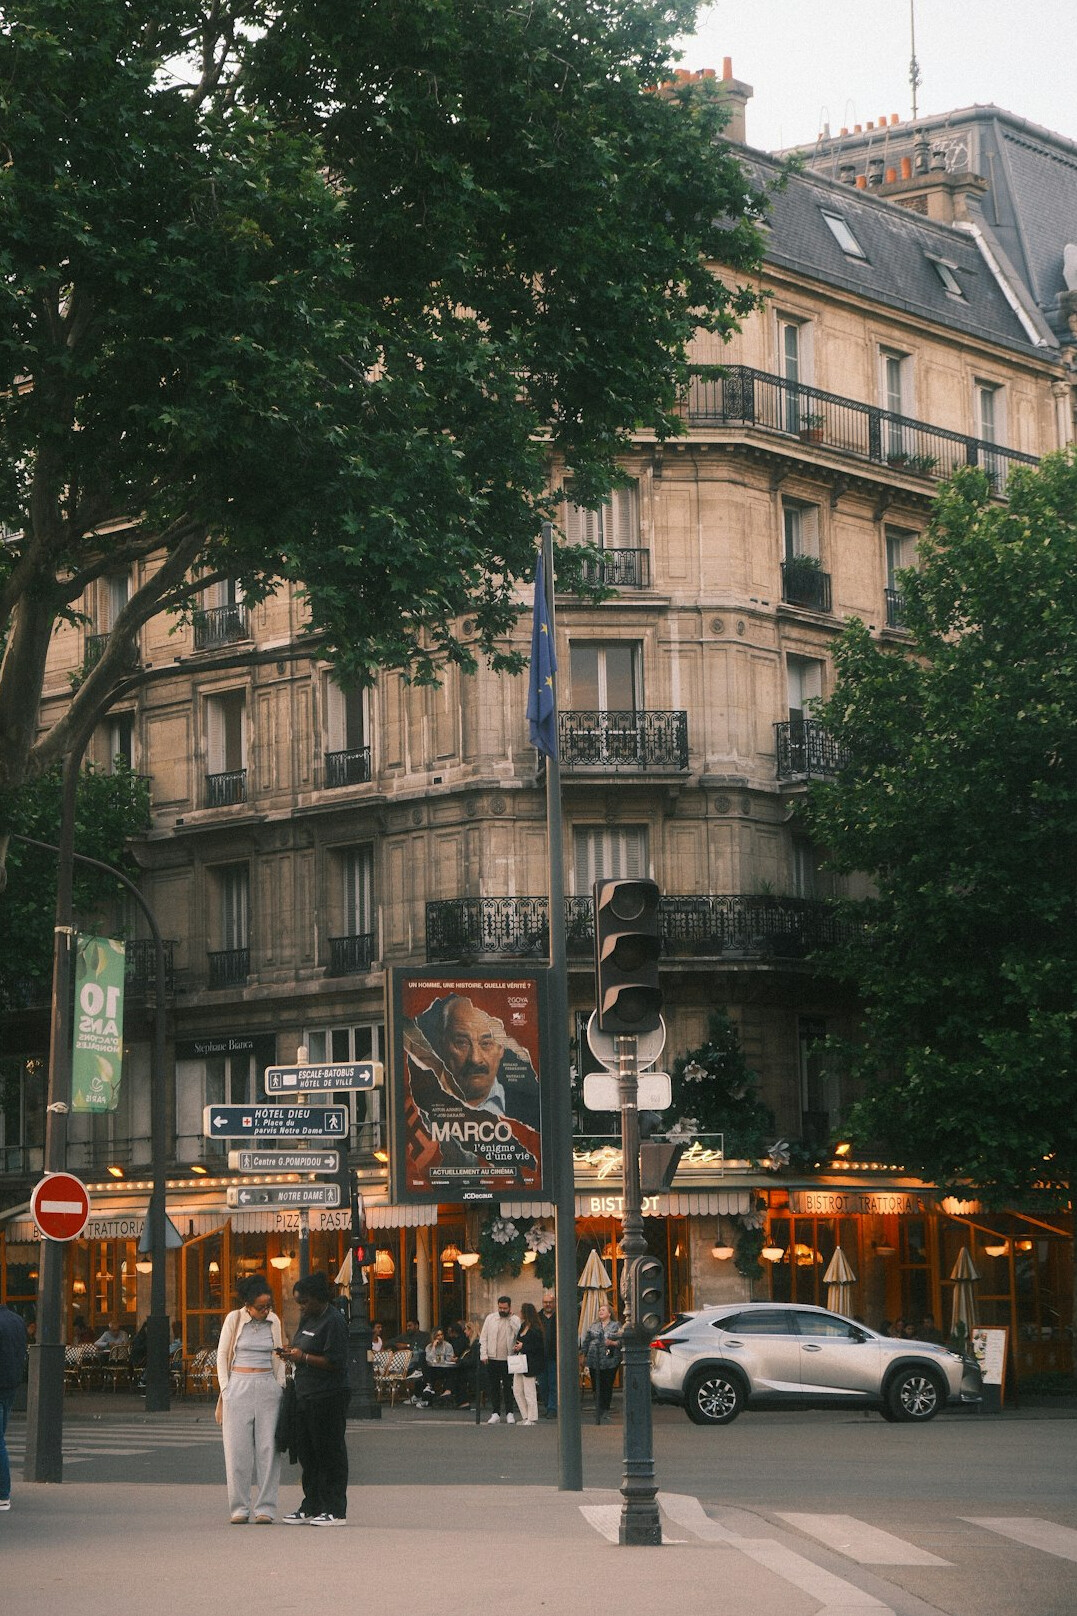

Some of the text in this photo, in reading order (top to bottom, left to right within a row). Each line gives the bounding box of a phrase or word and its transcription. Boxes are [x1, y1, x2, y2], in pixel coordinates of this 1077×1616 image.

[507, 981, 527, 989] VÉRITÉ
[298, 1067, 355, 1079] ESCALE-BATOBUS
[300, 1078, 353, 1088] HÔTEL DE VILLE
[254, 1108, 310, 1119] HÔTEL DIEU
[254, 1127, 277, 1135] parvis
[431, 1121, 512, 1142] MARCO
[474, 1144, 516, 1154] l'énigme
[253, 1157, 322, 1166] Centre G.POMPIDOU
[485, 1152, 530, 1161] d'une vie
[490, 1167, 514, 1175] CINÉMA
[278, 1191, 323, 1201] NOTRE DAME
[463, 1192, 493, 1200] JCDecaux
[590, 1196, 660, 1212] BISTOT
[806, 1195, 850, 1210] BISTROT
[859, 1196, 911, 1211] TRATTORIA
[276, 1214, 300, 1228] PIZZ
[88, 1221, 145, 1236] TRATTORIA
